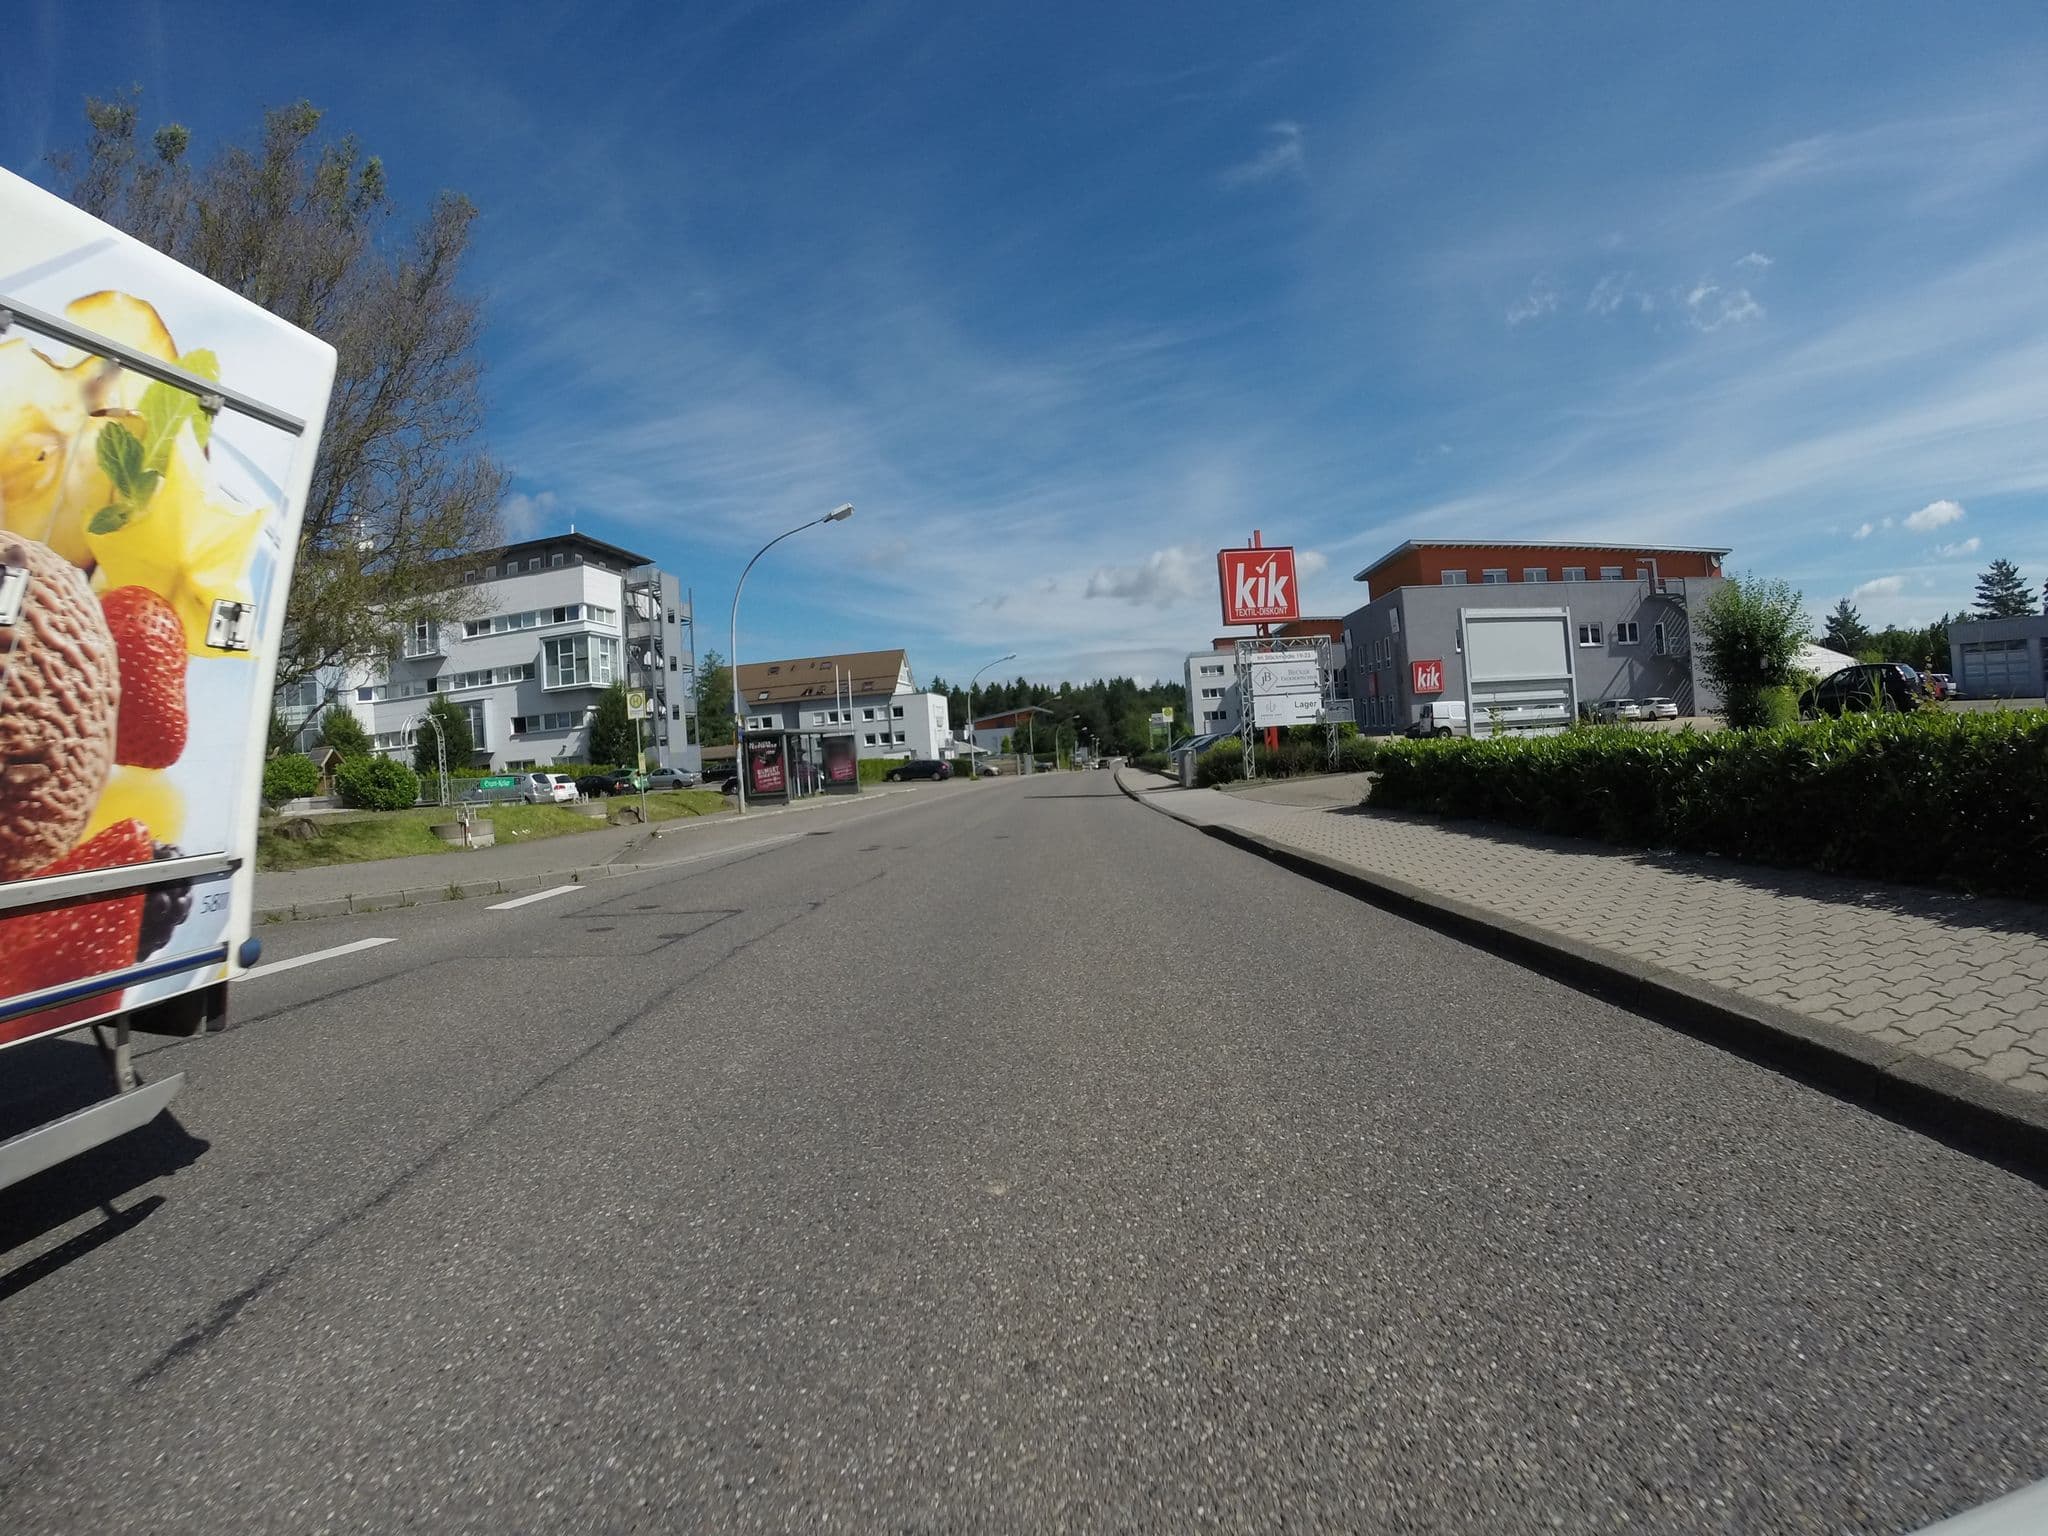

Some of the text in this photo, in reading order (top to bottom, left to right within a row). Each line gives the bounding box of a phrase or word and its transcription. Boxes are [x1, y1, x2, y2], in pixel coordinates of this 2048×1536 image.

[1235, 553, 1289, 608] kik
[1235, 606, 1288, 617] TEXTIL-DISKONT
[1417, 662, 1440, 688] kik
[1294, 701, 1317, 709] Lager
